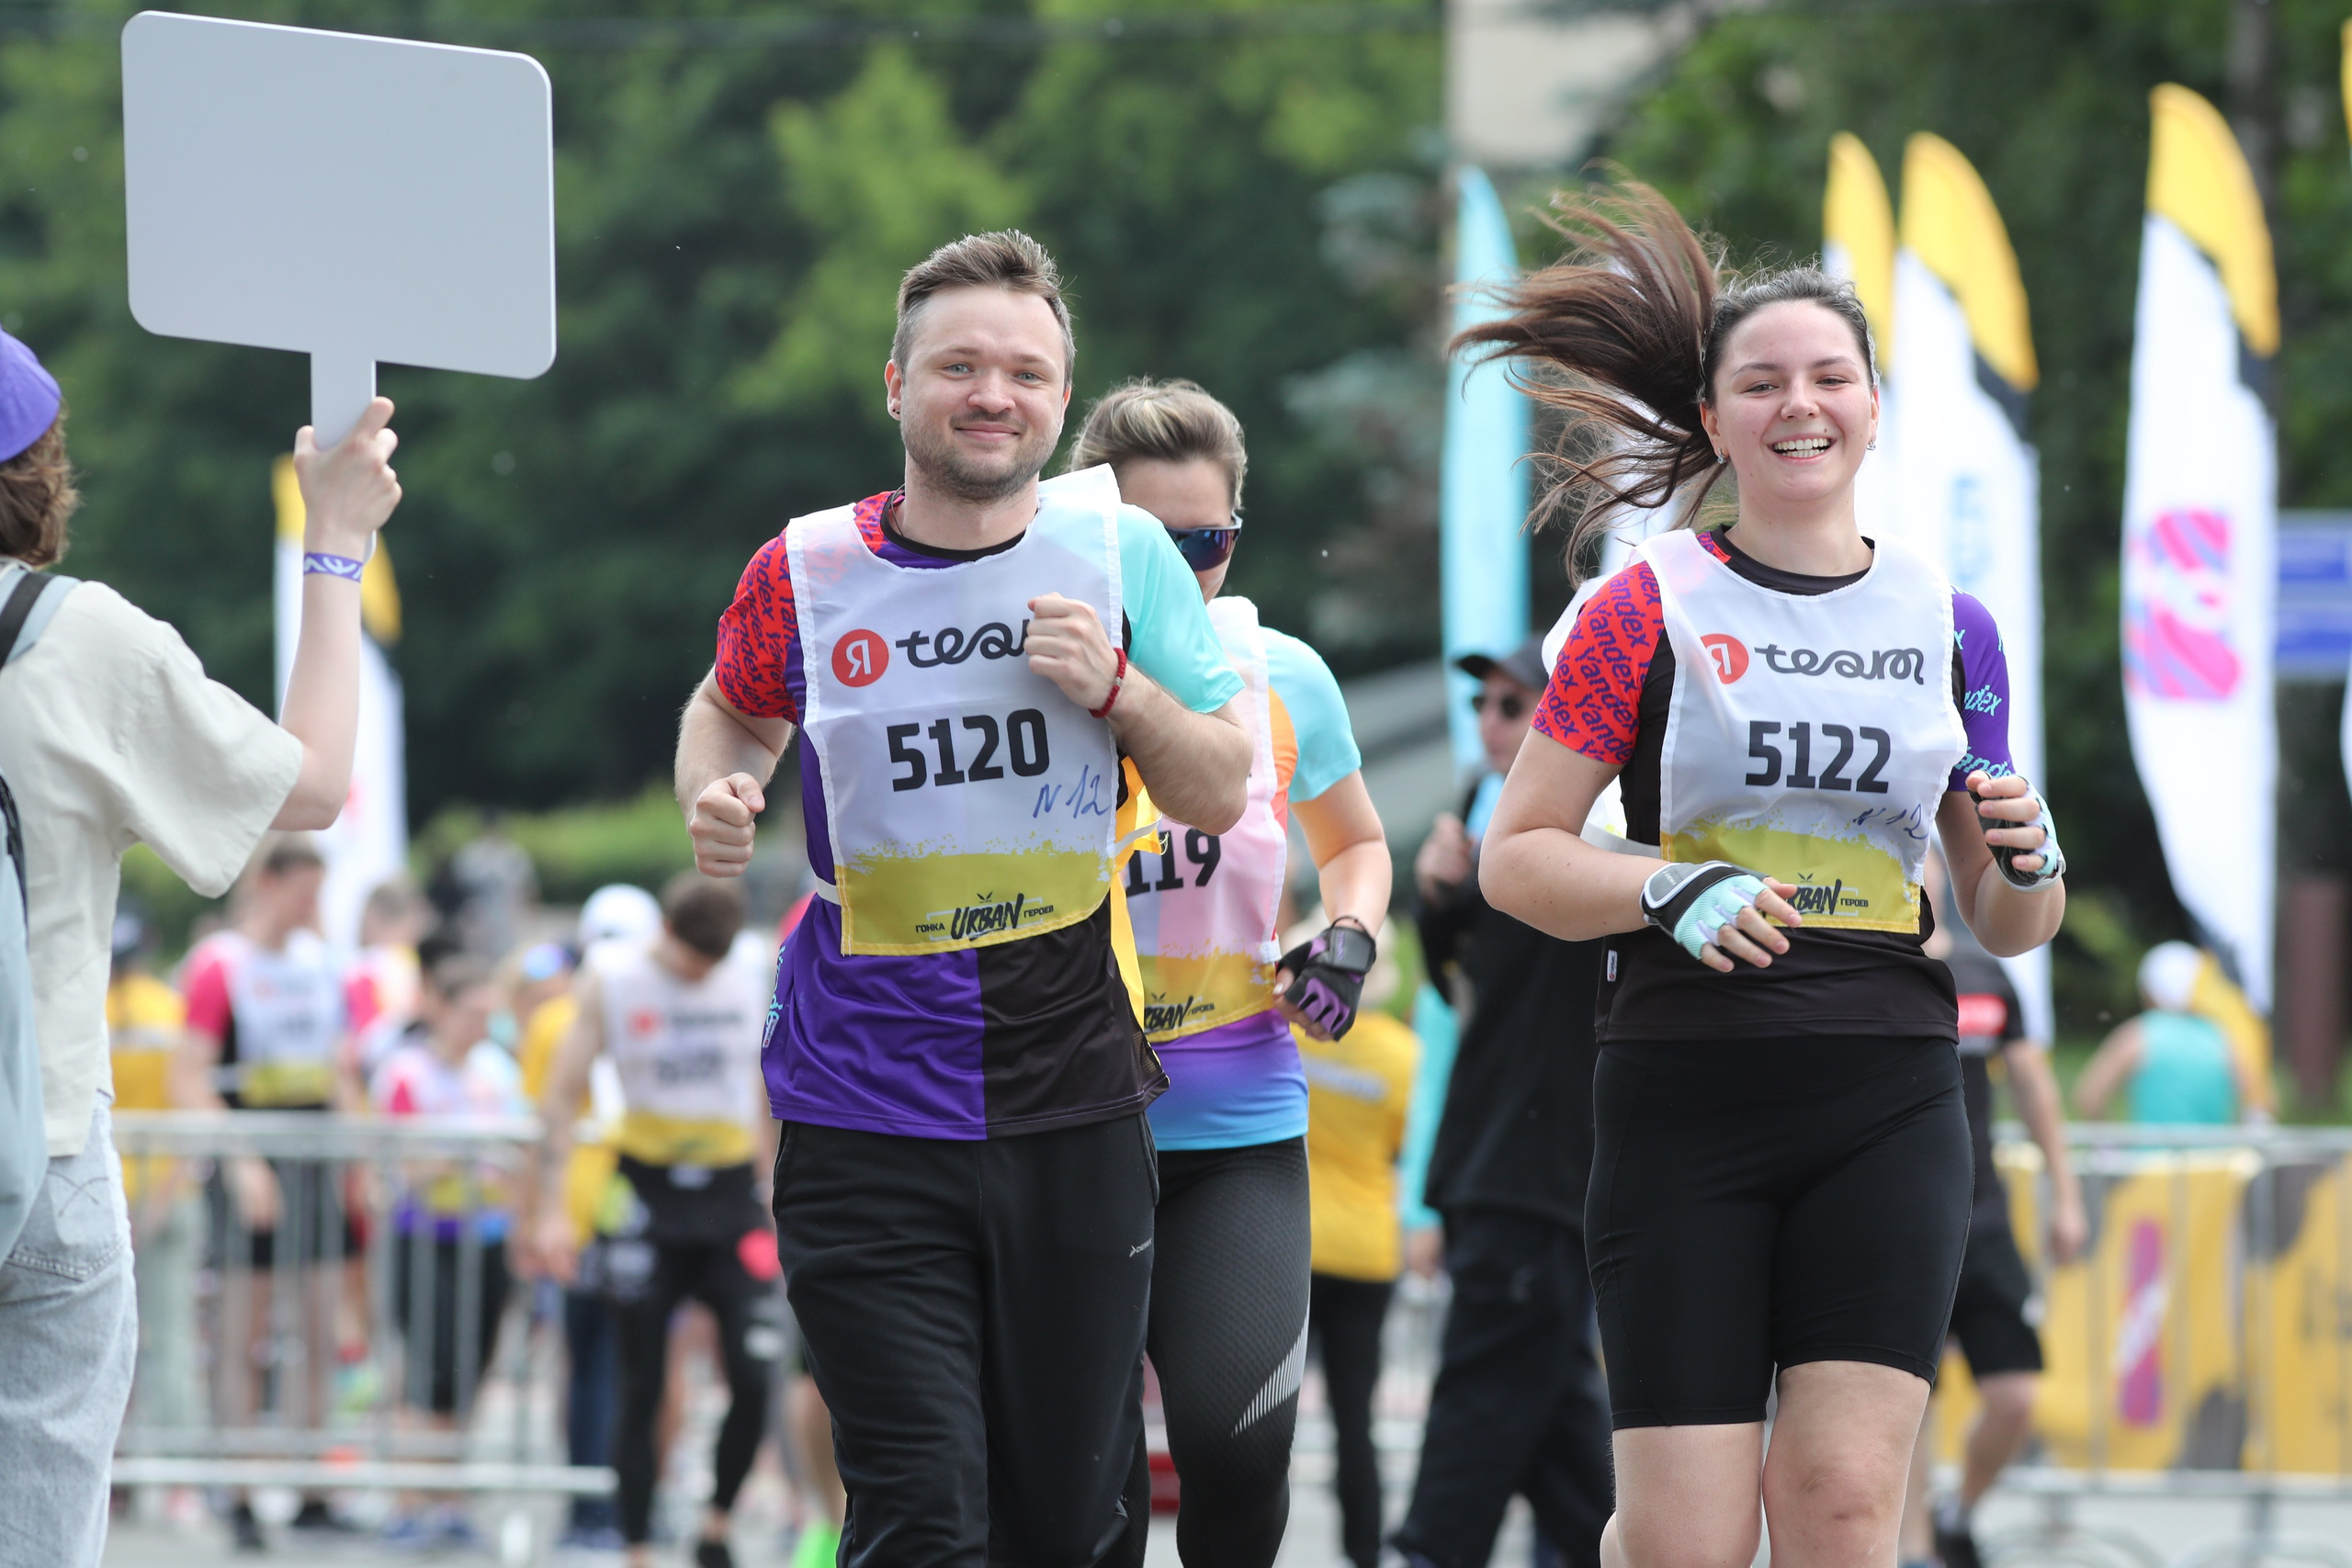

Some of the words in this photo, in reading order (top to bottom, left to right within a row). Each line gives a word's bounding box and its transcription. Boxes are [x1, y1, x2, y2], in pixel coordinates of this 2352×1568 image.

[895, 618, 1030, 669] tea
[1588, 599, 1639, 694] Yandex
[1754, 643, 1925, 686] team
[1575, 645, 1639, 735] Yandex
[887, 708, 1050, 792] 5120
[1575, 693, 1634, 764] Yande
[1745, 720, 1891, 794] 5122
[1065, 764, 1111, 819] 12
[1126, 828, 1221, 897] 119
[915, 922, 945, 934] ГОНКА
[950, 892, 1025, 942] URBAN
[1023, 904, 1055, 919] ГЕРОЕВ
[1840, 897, 1869, 908] ГЕРОЕВ
